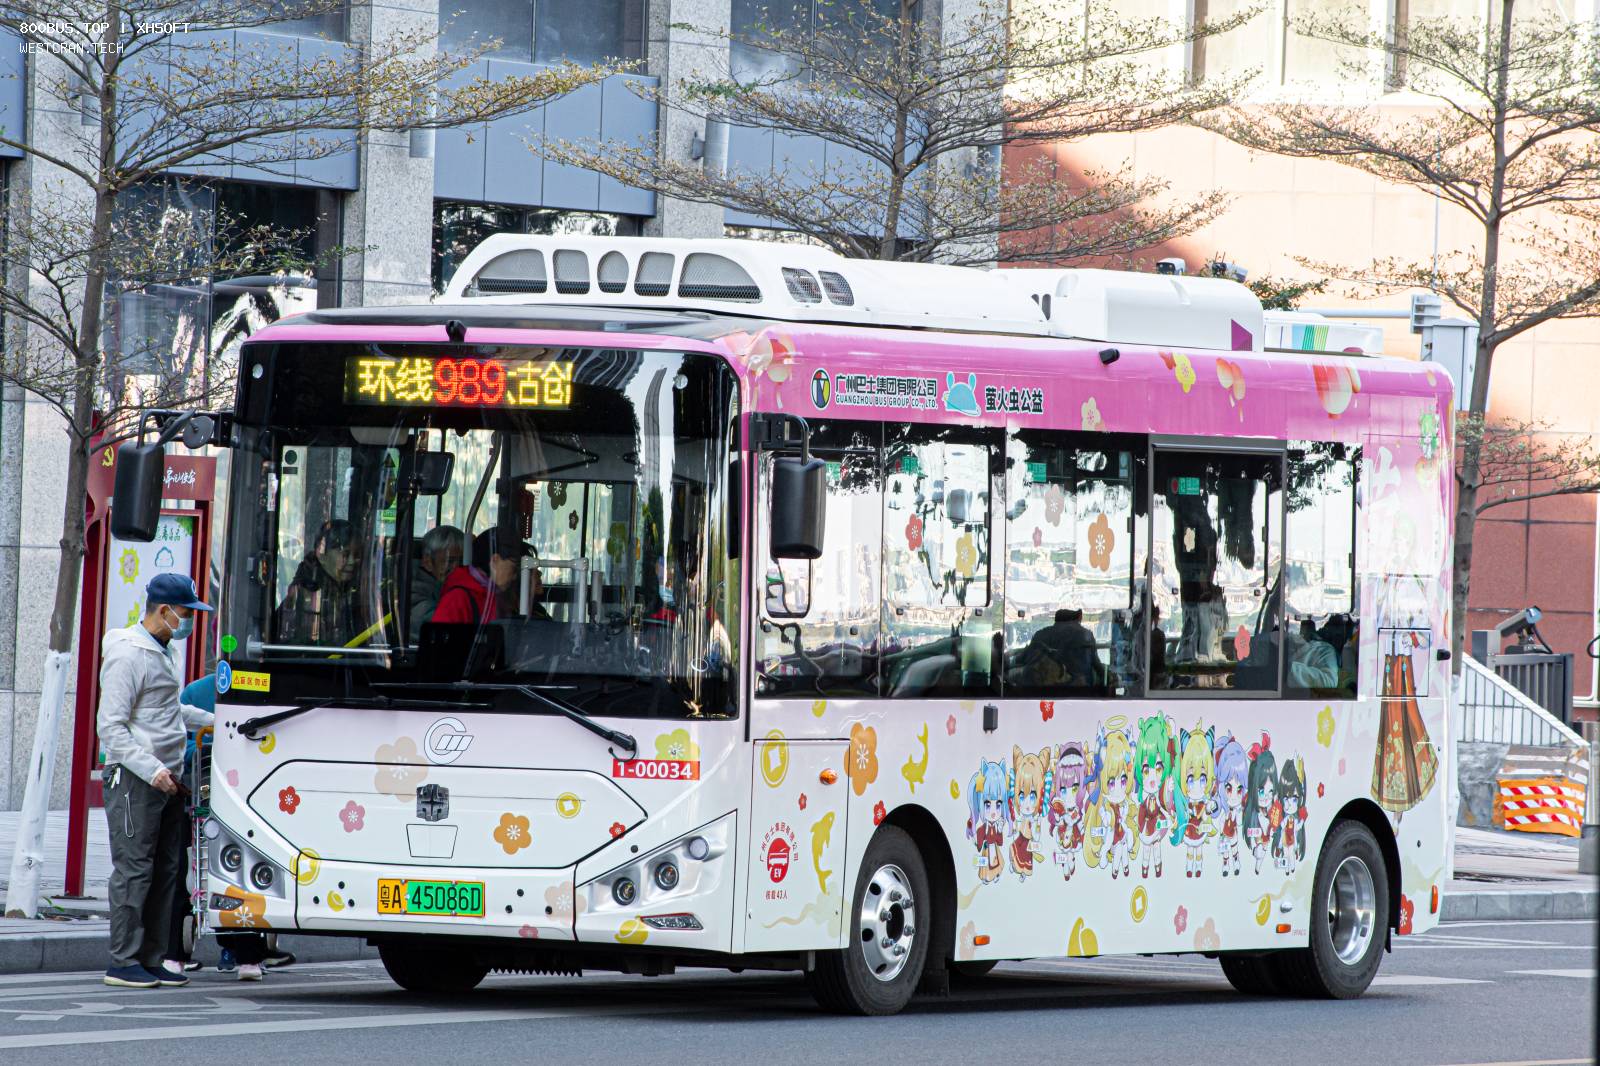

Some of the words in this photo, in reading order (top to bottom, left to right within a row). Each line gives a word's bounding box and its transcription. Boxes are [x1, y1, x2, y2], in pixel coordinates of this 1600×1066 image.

[835, 374, 937, 397] 广州巴士集团有限公司
[835, 394, 873, 406] GUANGZHOU
[874, 396, 887, 406] BUS
[888, 396, 910, 407] GROUP
[985, 387, 1044, 413] 萤火虫公益
[616, 761, 693, 779] 1-00034
[380, 885, 402, 909] 粤A
[411, 885, 481, 911] 45086D
